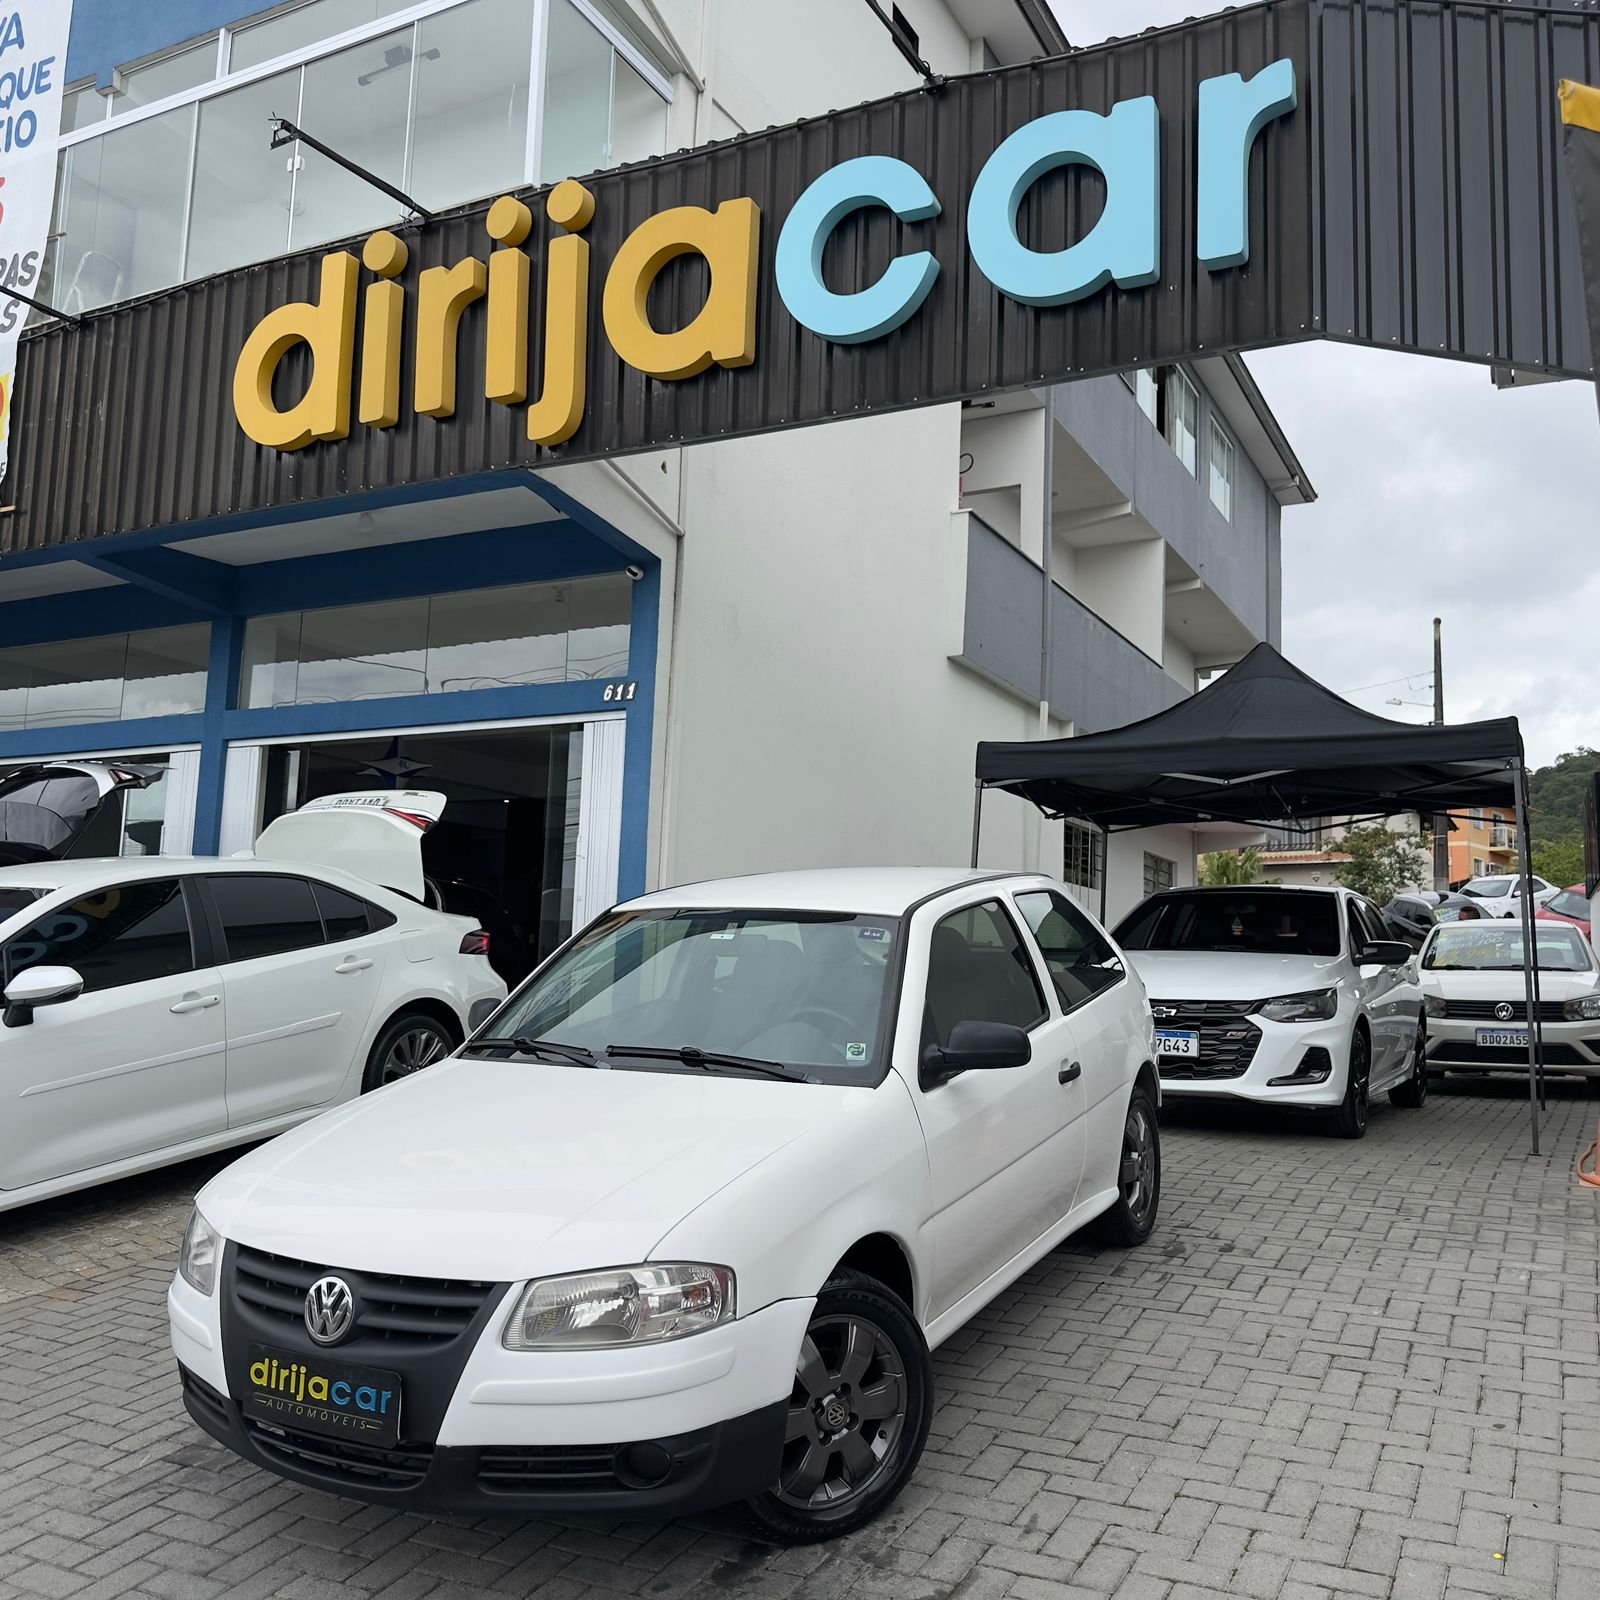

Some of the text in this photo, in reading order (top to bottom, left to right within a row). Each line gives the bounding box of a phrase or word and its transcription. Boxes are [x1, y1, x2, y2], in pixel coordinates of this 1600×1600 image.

[0, 110, 37, 153] IO
[233, 58, 1299, 451] dirijacar
[603, 682, 636, 701] 611
[250, 1357, 392, 1415] dirijacar
[265, 1398, 368, 1430] AUTOMÓVEIS
